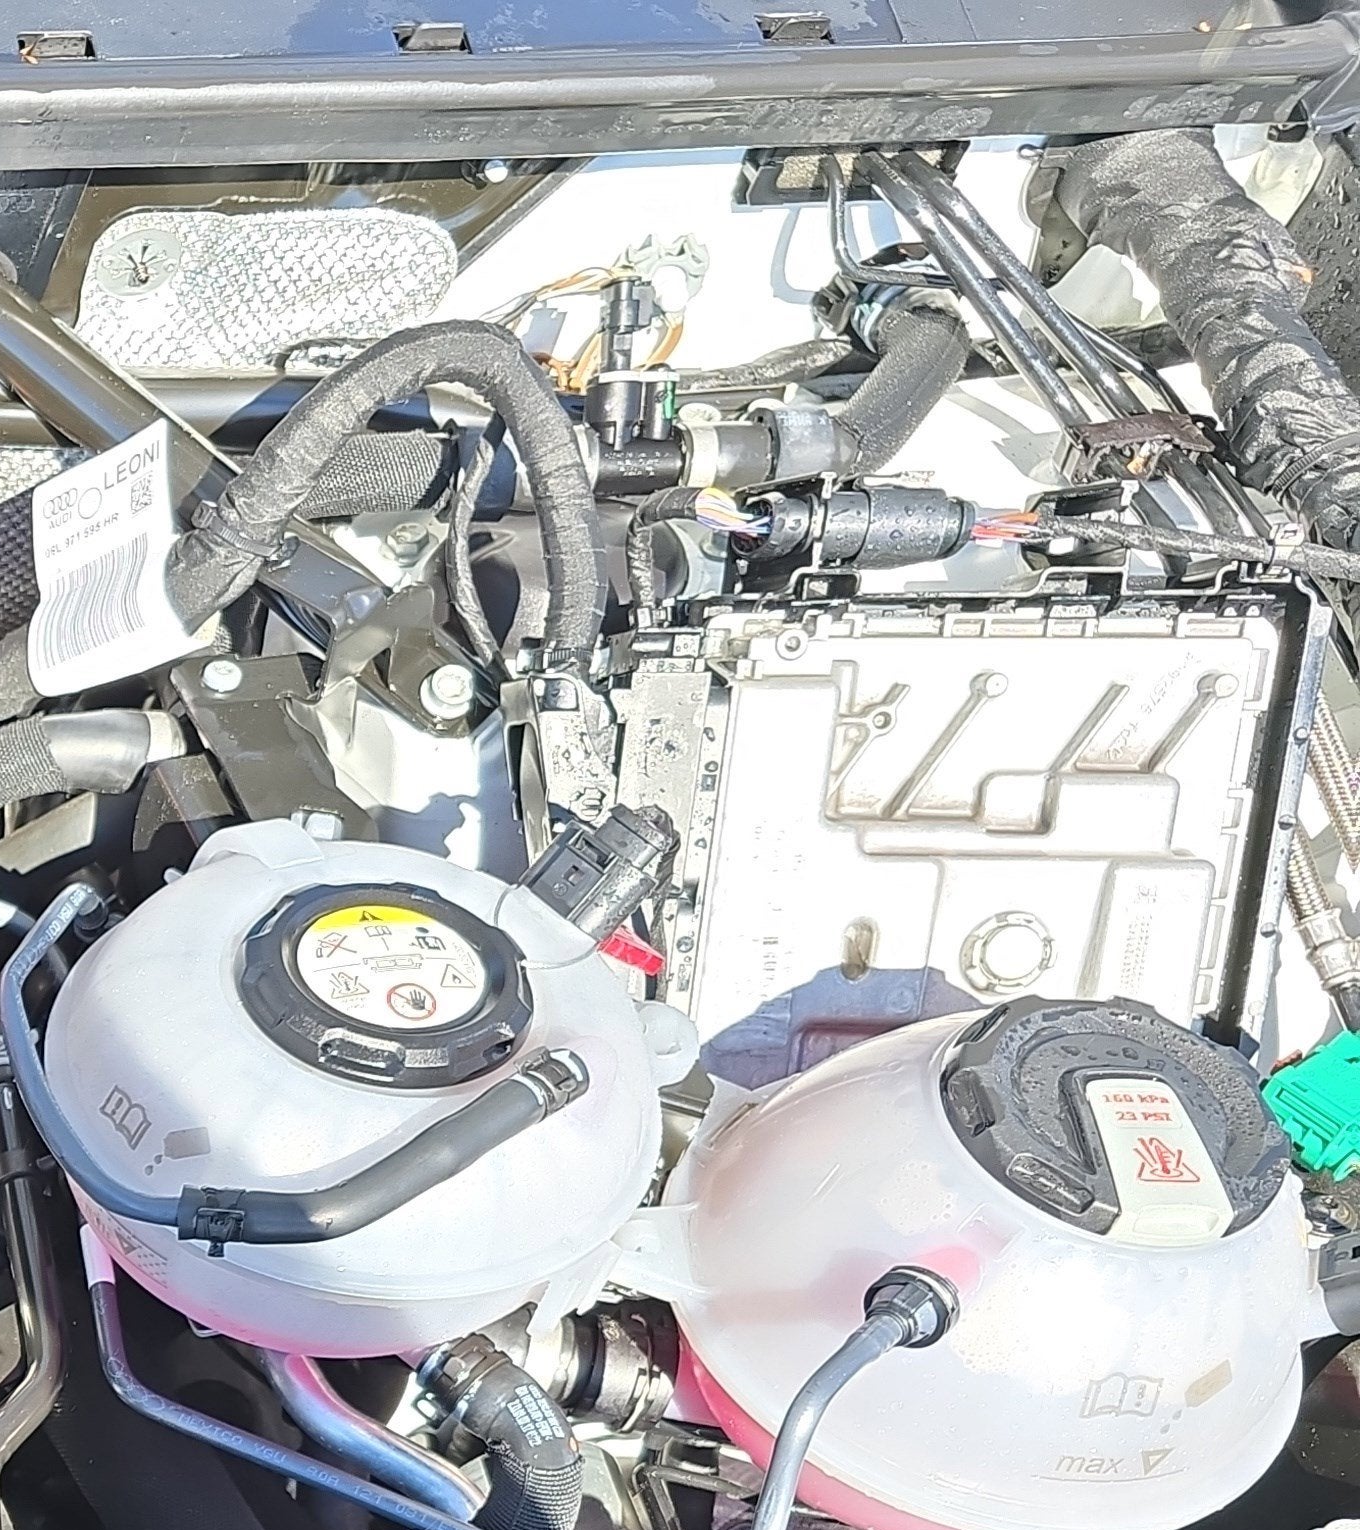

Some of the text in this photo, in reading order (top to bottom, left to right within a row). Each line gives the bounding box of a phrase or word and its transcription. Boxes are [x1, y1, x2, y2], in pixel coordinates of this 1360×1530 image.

[104, 440, 160, 489] LEONI
[48, 510, 72, 530] AUDI
[1139, 1092, 1170, 1104] kPa
[1116, 1111, 1172, 1122] 23 PSI
[178, 1414, 243, 1445] MEXICO
[1054, 1454, 1124, 1475] max
